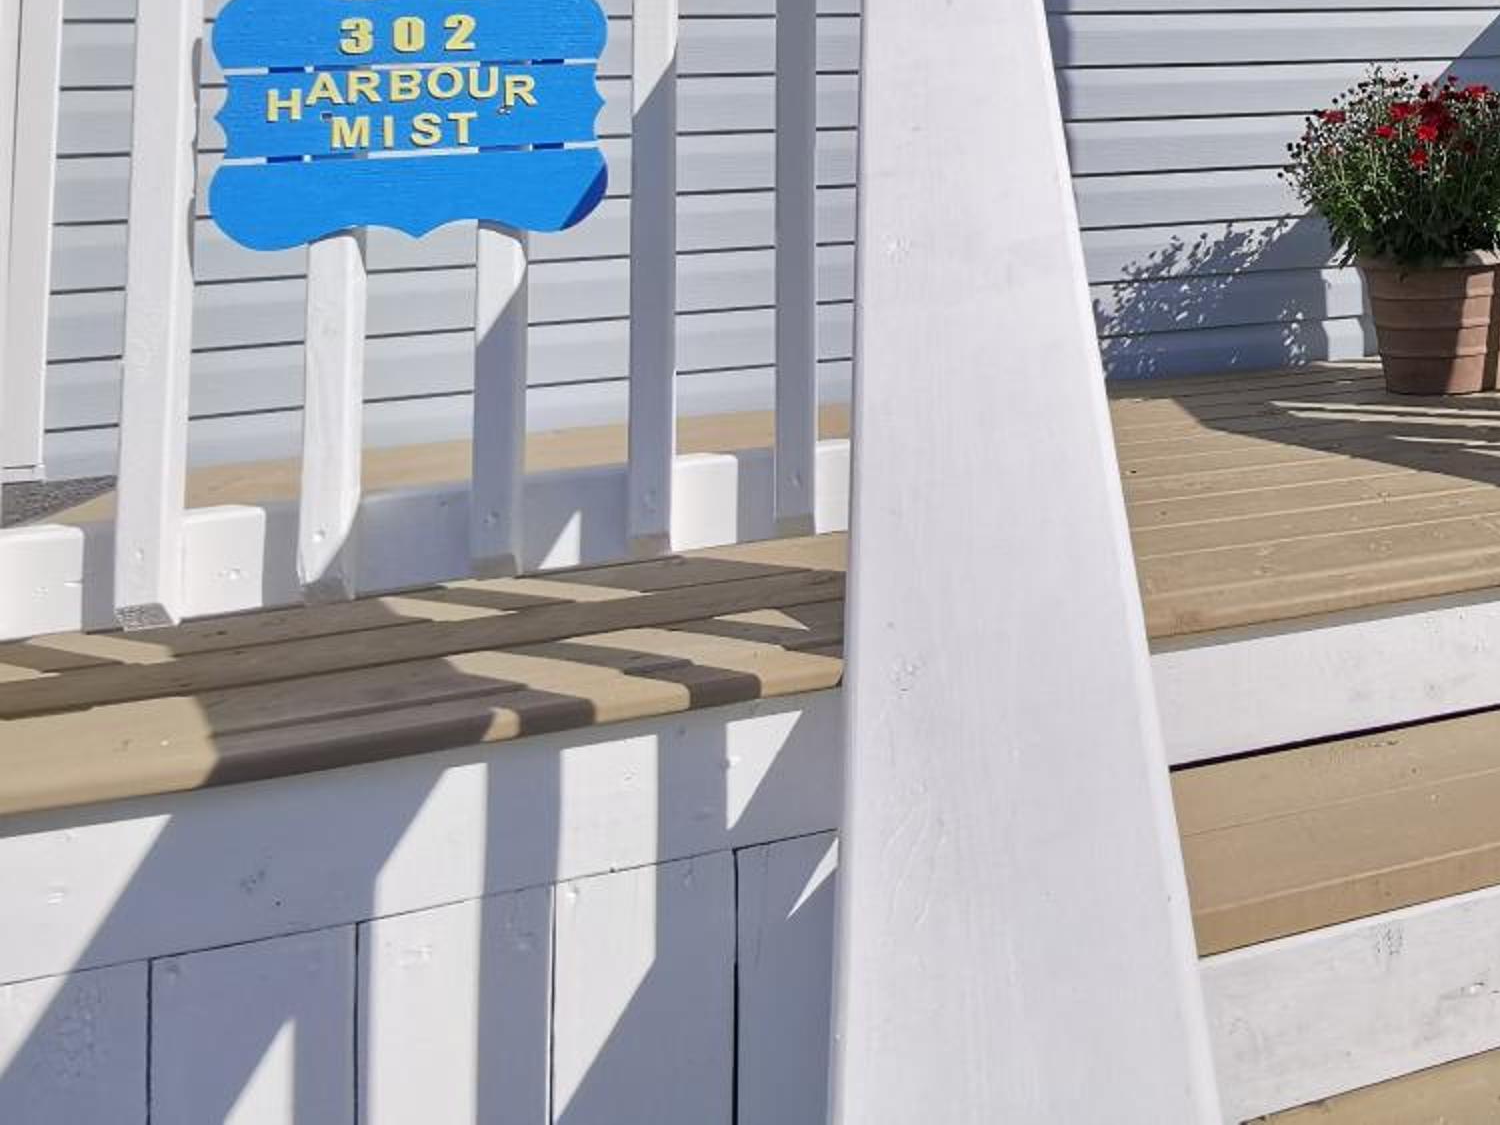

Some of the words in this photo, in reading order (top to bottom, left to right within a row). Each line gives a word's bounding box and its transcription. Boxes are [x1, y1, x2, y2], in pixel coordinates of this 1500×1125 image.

[340, 14, 476, 54] 302
[266, 66, 538, 122] HARBOUR
[330, 111, 478, 149] MIST
